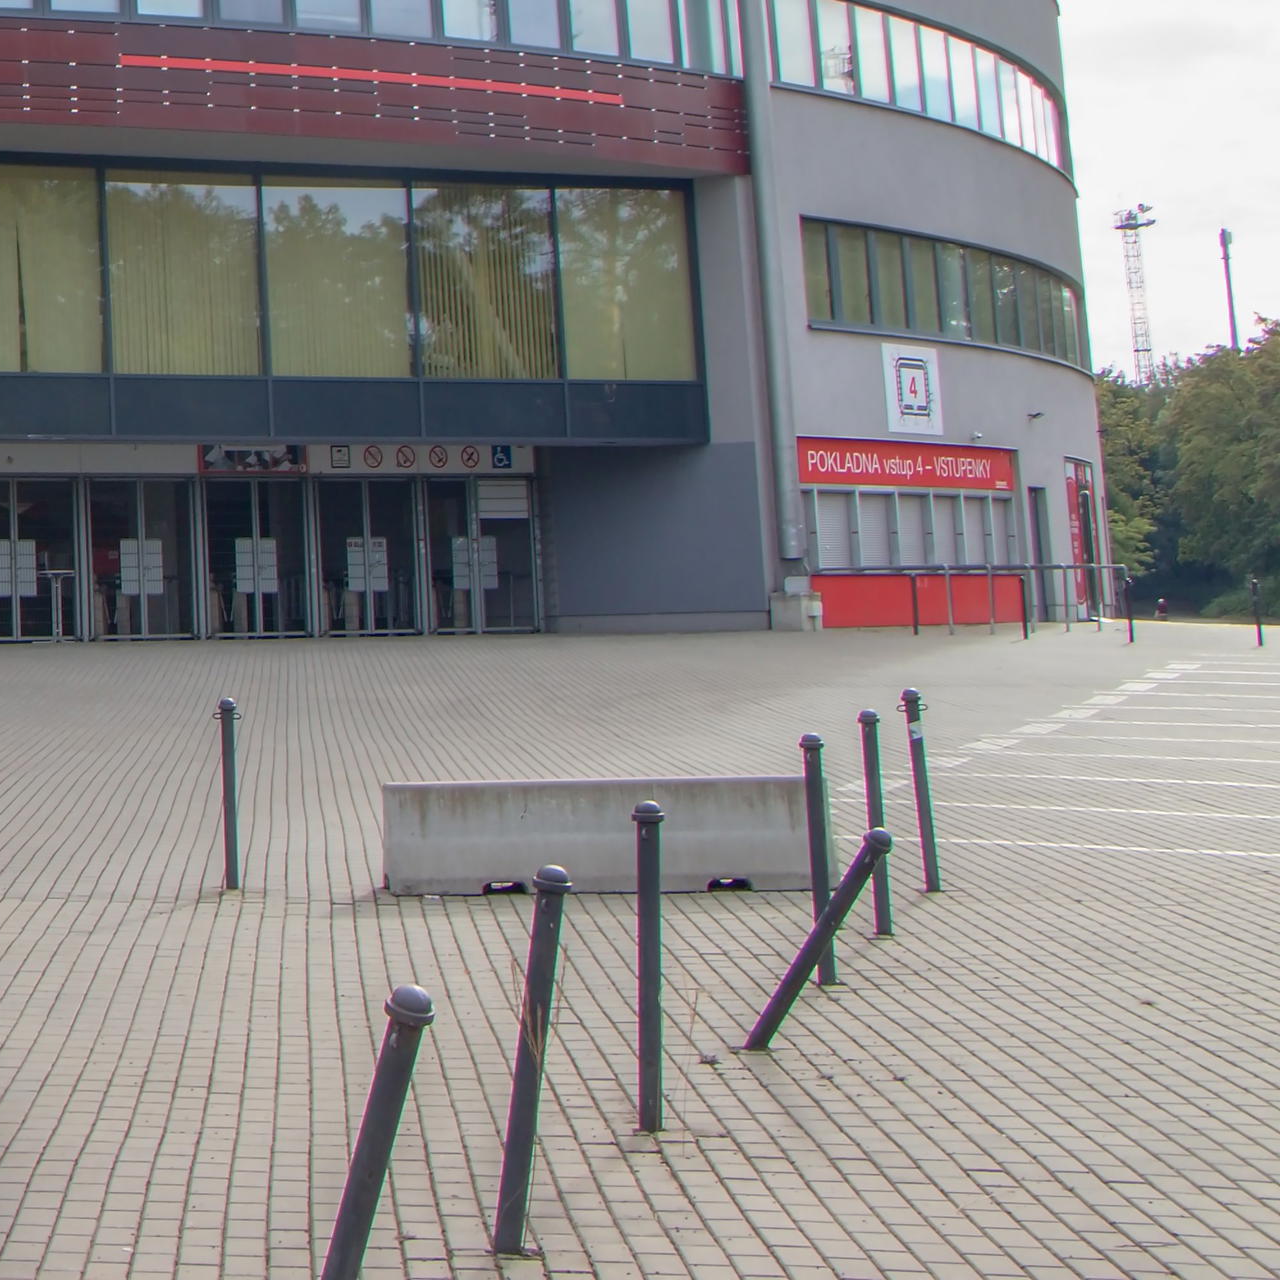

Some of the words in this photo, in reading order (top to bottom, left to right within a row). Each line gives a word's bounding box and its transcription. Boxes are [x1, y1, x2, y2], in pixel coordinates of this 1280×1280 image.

[908, 375, 918, 399] 4
[807, 450, 881, 474] POKLADNA
[883, 456, 913, 480] vstup
[915, 455, 923, 472] 4
[933, 457, 991, 480] VSTUPENKY
